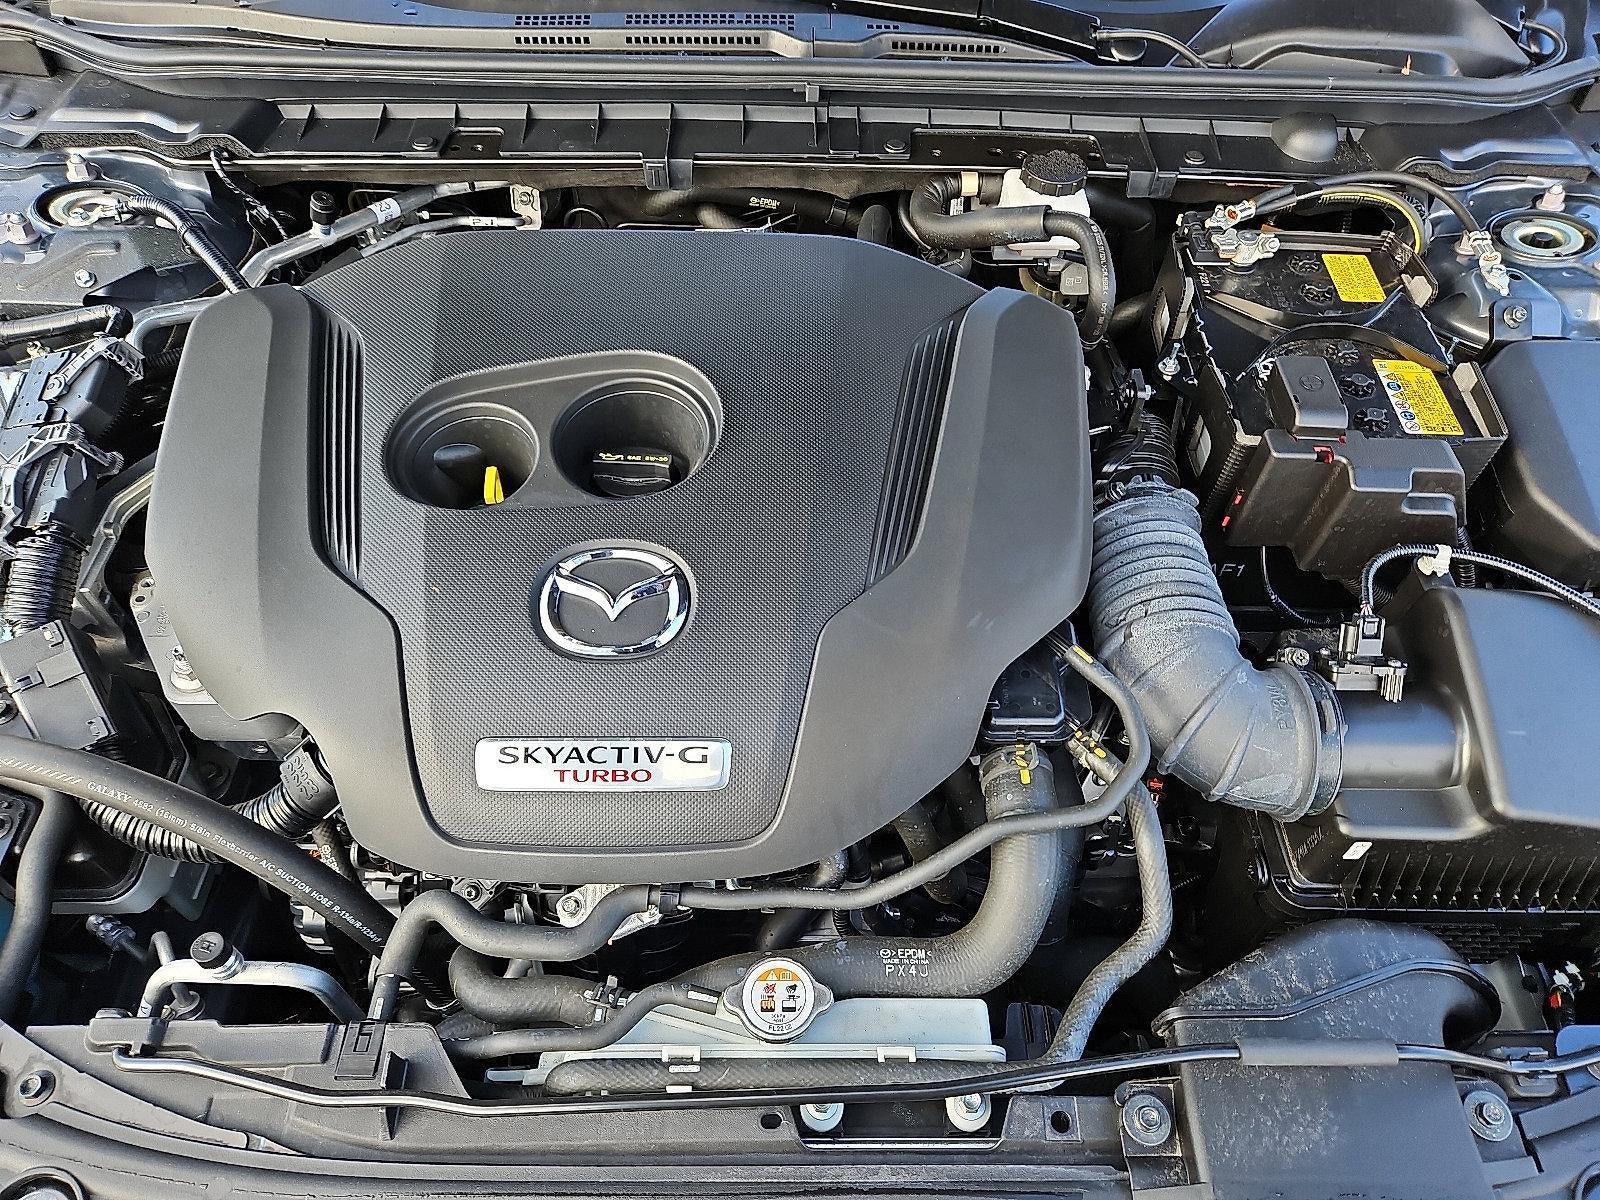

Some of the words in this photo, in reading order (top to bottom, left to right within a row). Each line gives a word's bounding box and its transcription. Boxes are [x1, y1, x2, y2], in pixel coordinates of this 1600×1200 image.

[498, 746, 709, 764] SKYACTIV-G
[553, 769, 652, 783] TURBO
[87, 781, 132, 802] GALAXY
[259, 859, 276, 872] A/C
[274, 868, 312, 894] SUCTION
[310, 890, 334, 908] HOSE
